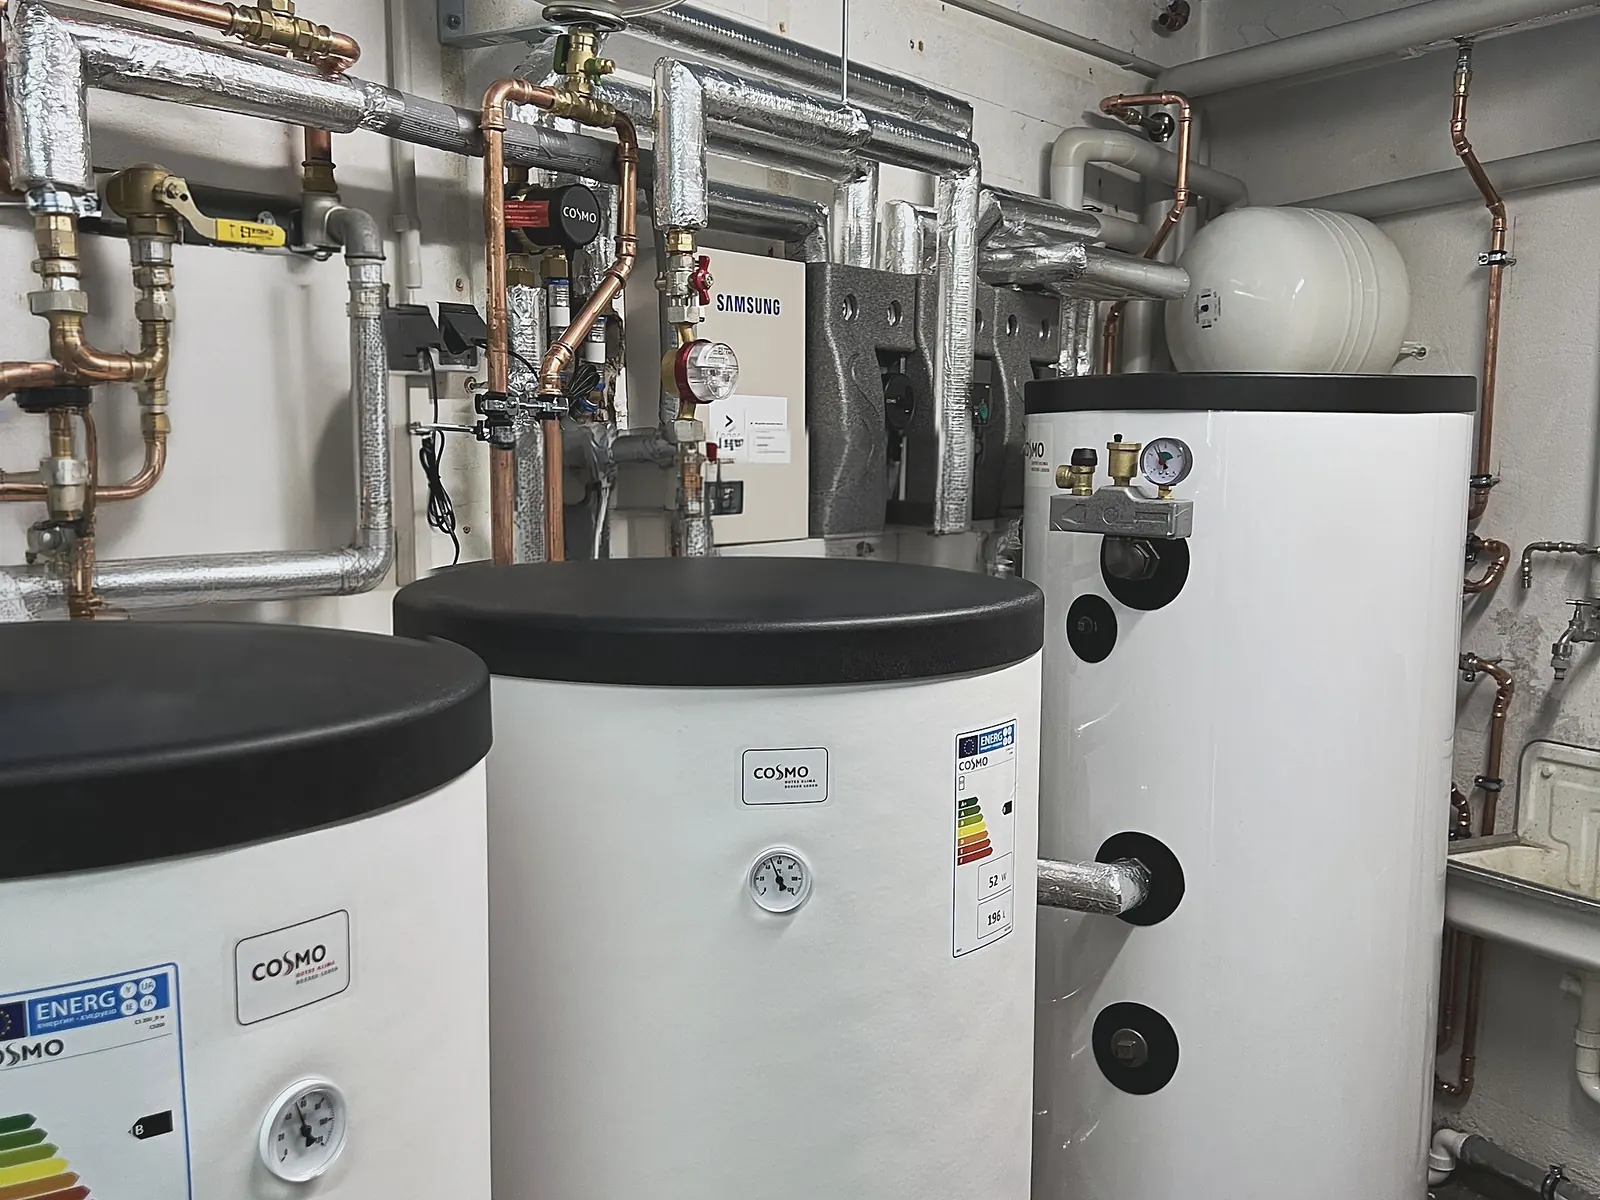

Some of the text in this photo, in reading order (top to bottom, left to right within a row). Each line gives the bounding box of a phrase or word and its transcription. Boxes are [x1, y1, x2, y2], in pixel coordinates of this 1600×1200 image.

[563, 206, 597, 224] COSMO
[716, 293, 781, 316] SAMSUNG
[1022, 440, 1045, 460] OSMO
[980, 731, 1003, 747] ENERG
[753, 763, 809, 781] COSMO
[958, 756, 989, 771] COSMO
[988, 874, 998, 889] 52
[987, 909, 1001, 926] 196
[251, 944, 327, 982] COSMO
[36, 990, 116, 1021] ENERG
[0, 1038, 65, 1067] SMO
[135, 1124, 144, 1136] B
